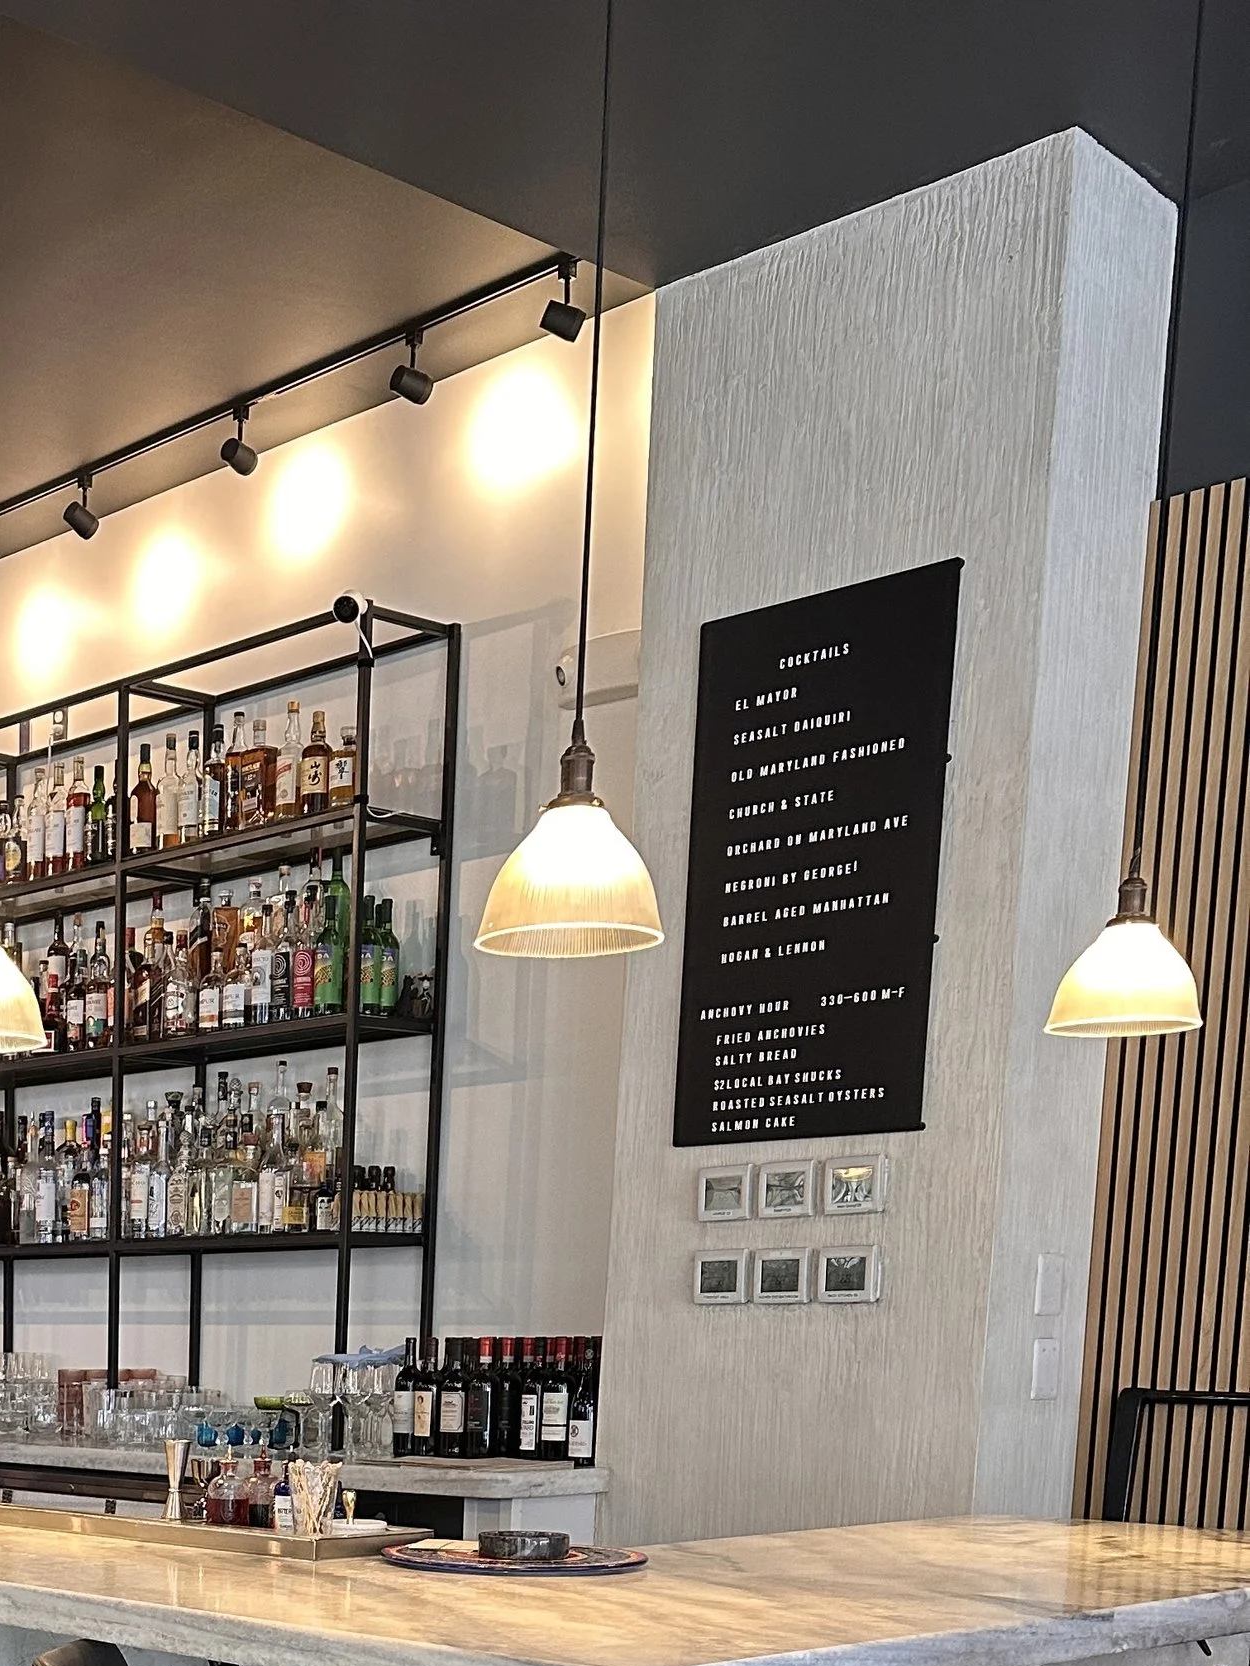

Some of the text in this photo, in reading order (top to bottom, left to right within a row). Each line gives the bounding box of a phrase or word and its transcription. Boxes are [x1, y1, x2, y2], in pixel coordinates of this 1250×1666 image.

[779, 642, 849, 670] COCKTAILS
[735, 687, 797, 712] EL MAYOR
[733, 710, 851, 746] SEASALT DAIQUIRI
[731, 737, 905, 783] OLD MARYLAND FASHIONED
[728, 789, 834, 820] CHURCH & STATE
[726, 814, 909, 857] ORCHARD ON MARYLAND AVE
[724, 860, 858, 894] NEGRONI BY GEORGE!
[722, 892, 889, 928] BARREL AGED MANHATTAN
[764, 947, 772, 959] &
[778, 939, 825, 957] LENNON
[881, 986, 905, 1000] M-F
[700, 1000, 789, 1021] ANCHOVY HOUR
[716, 1023, 825, 1046] FRIED ANCHOVIES
[715, 1048, 797, 1067] SALTY BREAD
[767, 1073, 791, 1086] BAY
[794, 1069, 842, 1084] SHUCKS
[712, 1087, 885, 1112] ROASTED SEASALT OYSTERS
[711, 1115, 796, 1133] SALMON CAKE
